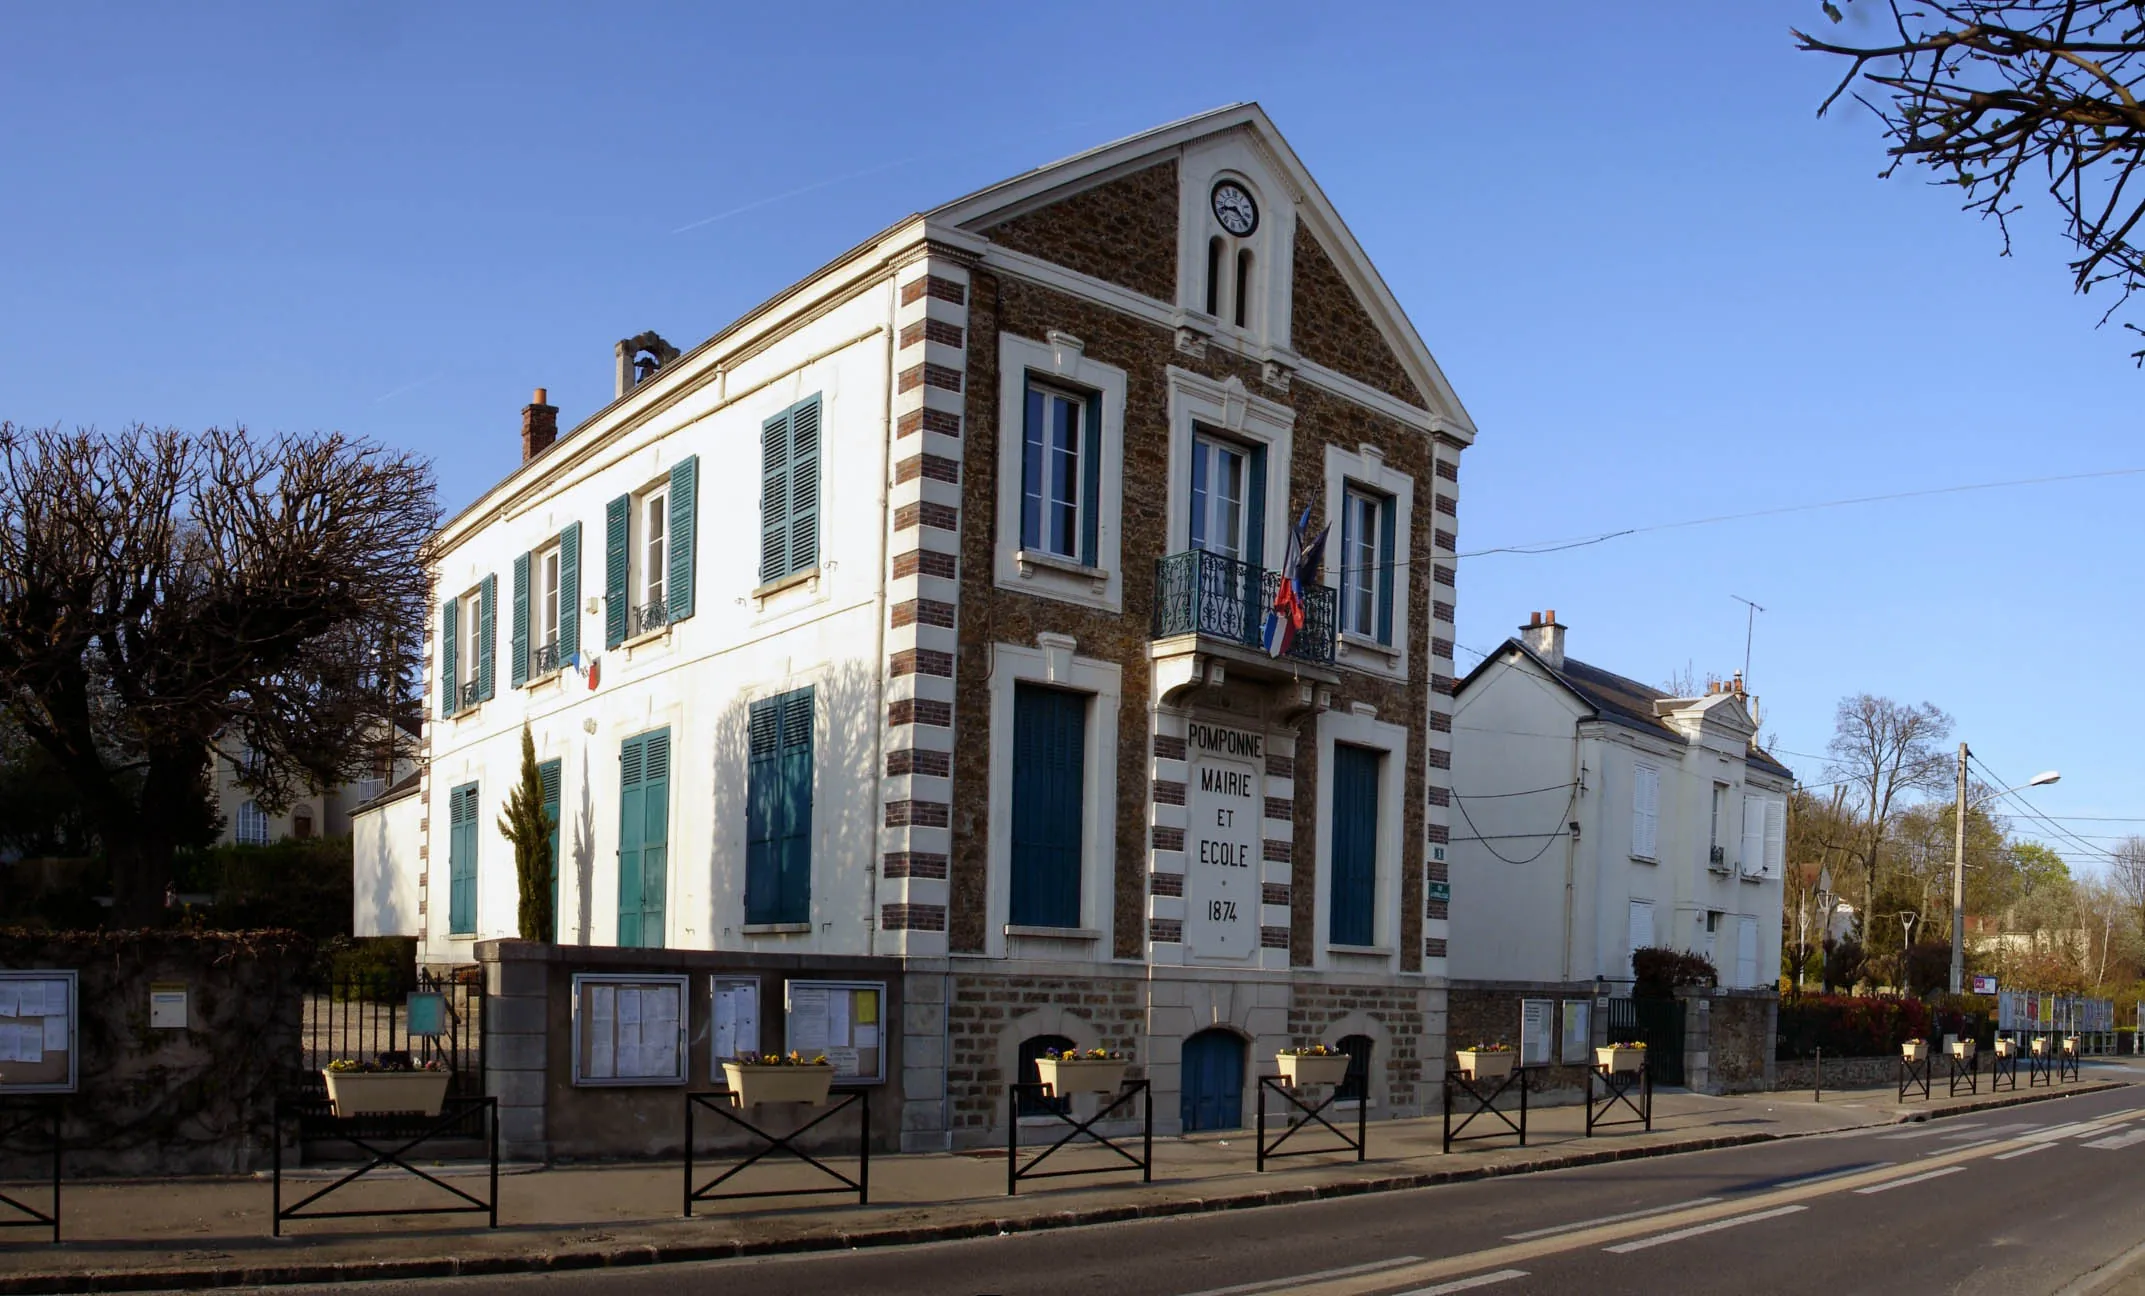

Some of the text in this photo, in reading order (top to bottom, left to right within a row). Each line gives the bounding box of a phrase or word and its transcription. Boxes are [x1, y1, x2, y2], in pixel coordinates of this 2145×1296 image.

[1188, 723, 1263, 758] POMPONNE
[1201, 768, 1251, 797] MAIRIE
[1217, 809, 1234, 828] ET
[1200, 840, 1248, 867] ECOLE
[1208, 900, 1237, 923] 1874
